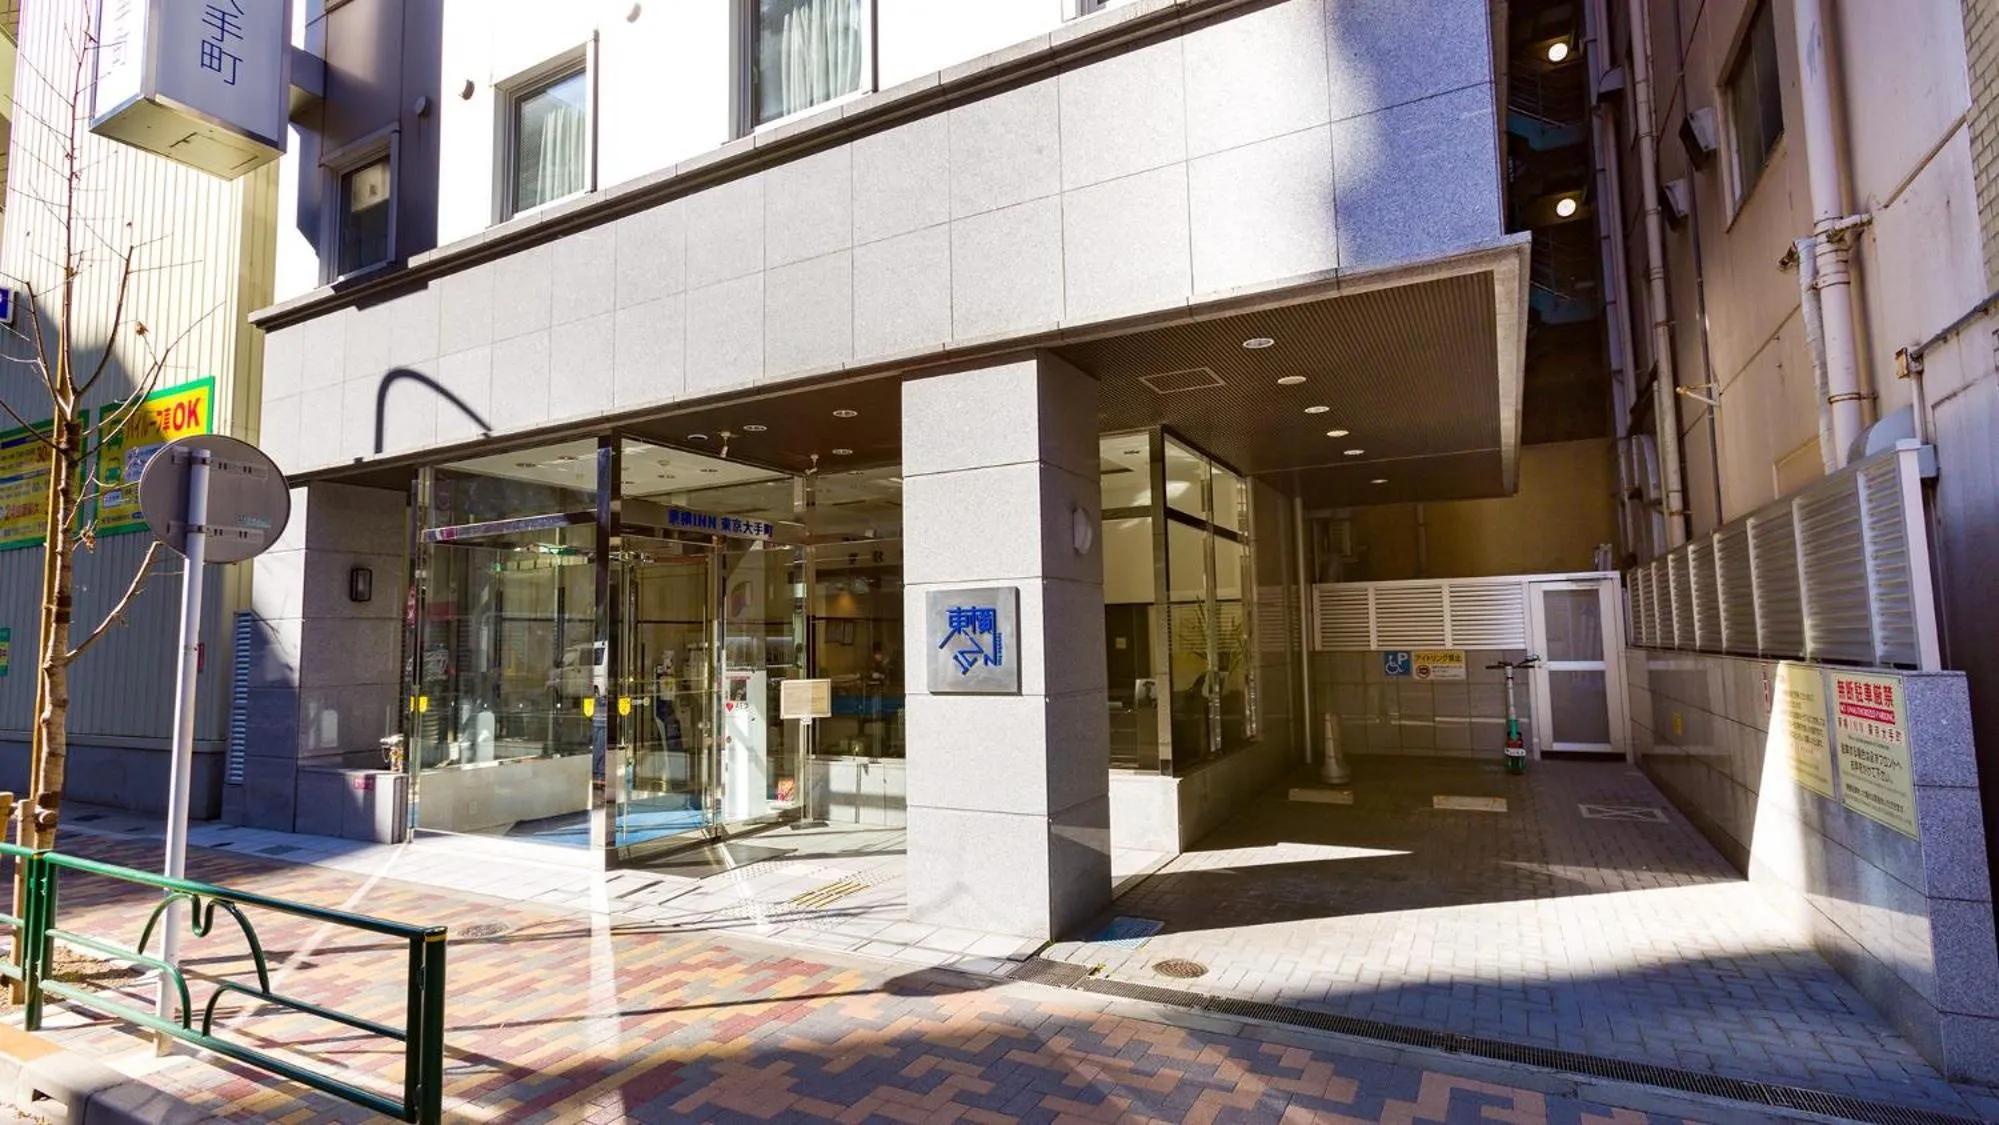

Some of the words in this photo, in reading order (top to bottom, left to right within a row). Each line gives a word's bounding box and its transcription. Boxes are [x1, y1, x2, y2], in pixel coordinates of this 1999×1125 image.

[201, 0, 245, 86] 手町
[720, 516, 774, 538] 東京大手町
[1836, 677, 1895, 708] 無断駐車厳禁
